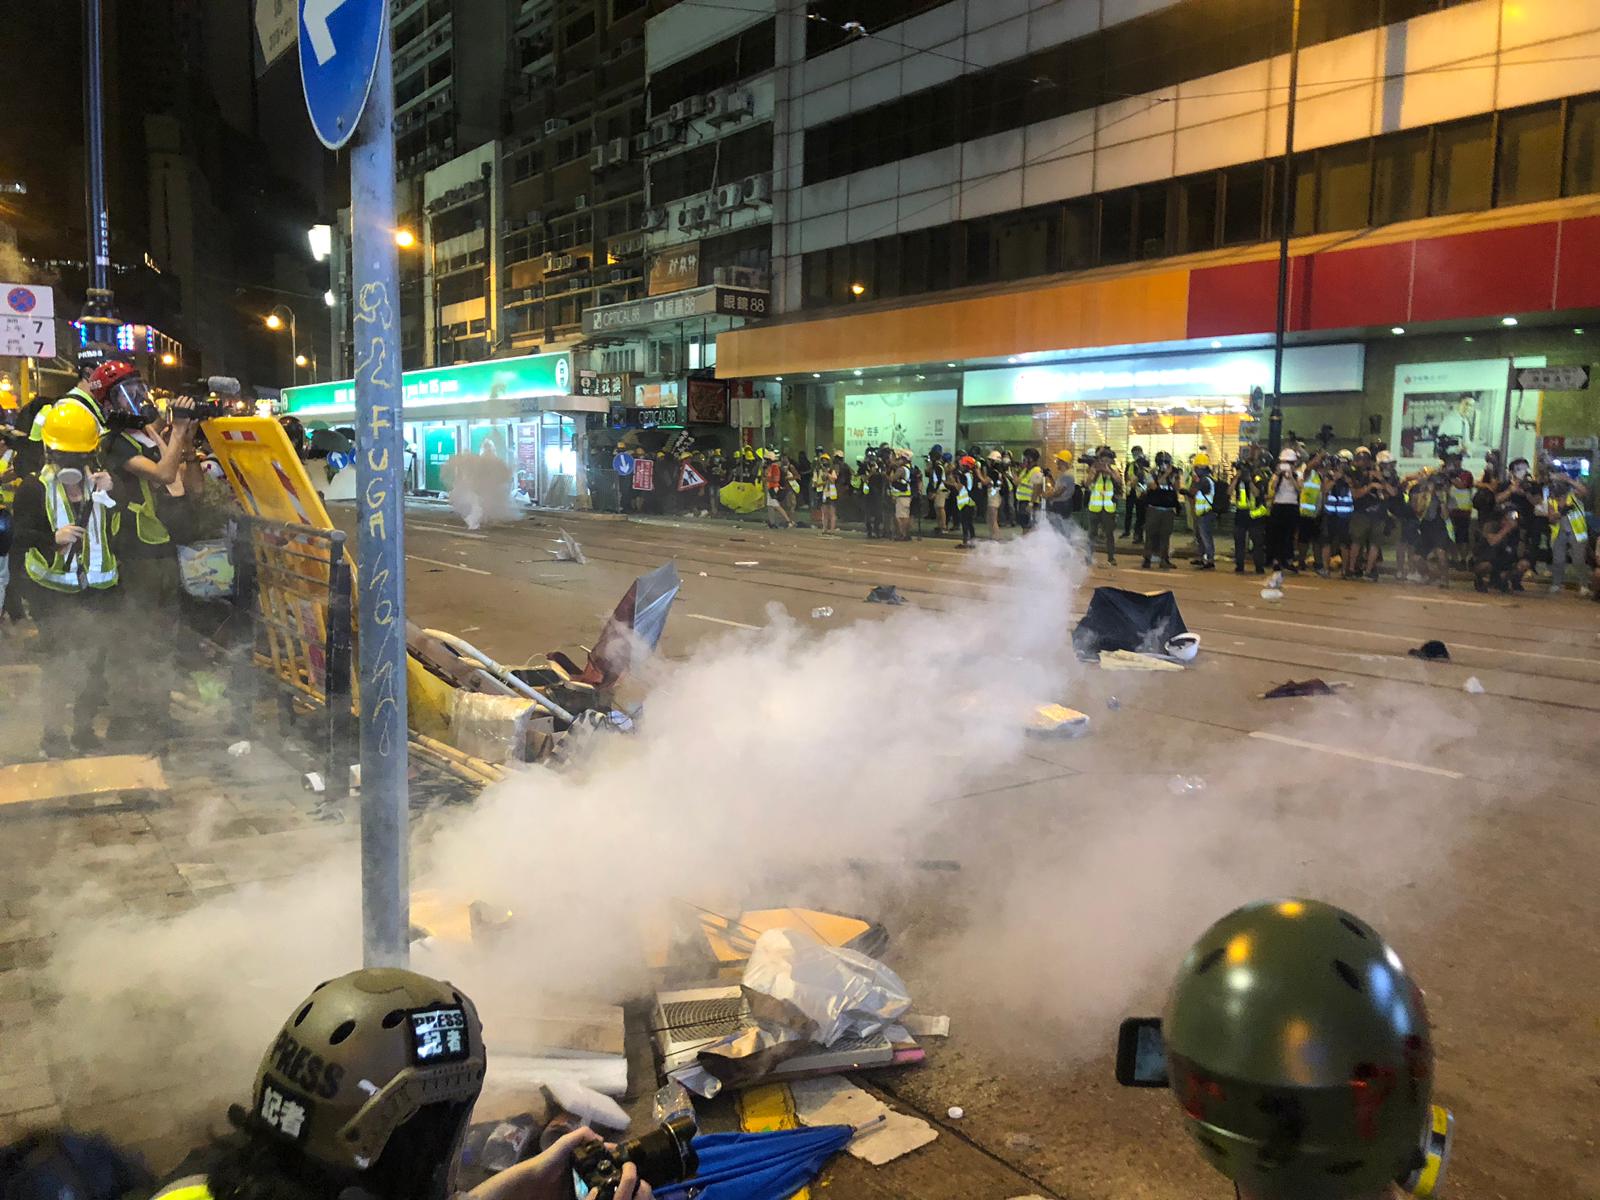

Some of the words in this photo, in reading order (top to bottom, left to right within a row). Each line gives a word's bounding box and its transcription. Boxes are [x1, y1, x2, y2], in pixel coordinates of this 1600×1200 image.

[723, 294, 765, 313] 眼鏡88
[33, 320, 43, 333] 7
[33, 341, 44, 354] 7
[414, 1010, 464, 1029] PRESS
[421, 1031, 462, 1057] 記者
[271, 1030, 346, 1099] PRESS
[260, 1086, 307, 1139] 記者
